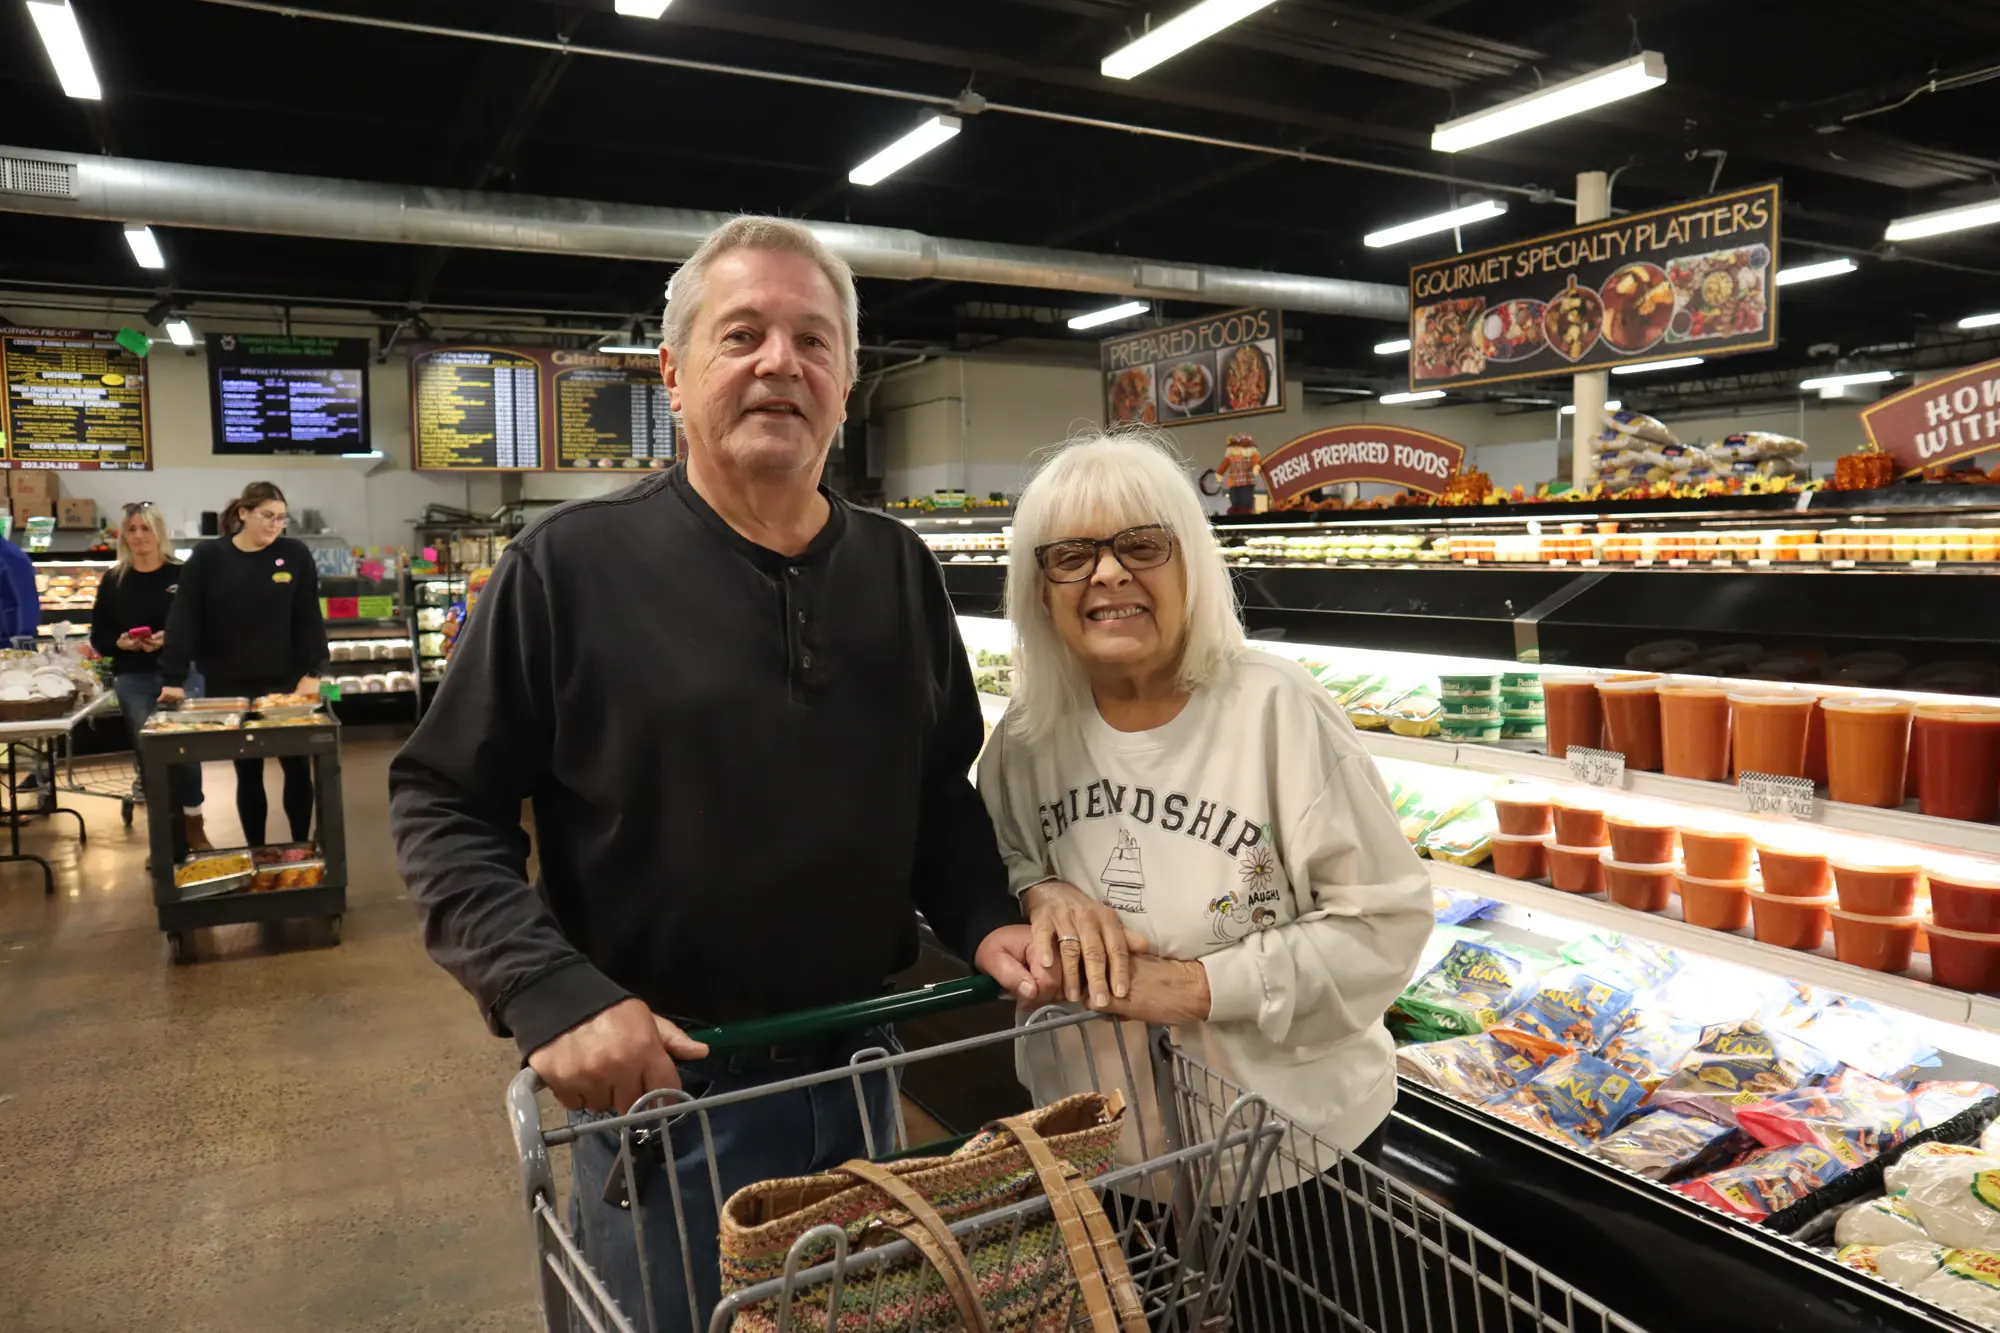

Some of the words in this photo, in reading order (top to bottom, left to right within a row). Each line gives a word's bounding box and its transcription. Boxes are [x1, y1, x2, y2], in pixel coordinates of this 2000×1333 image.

[1415, 255, 1513, 298] GOURMET
[1515, 228, 1632, 278] SPECIALTY
[1635, 198, 1769, 252] PLATTERS
[1110, 328, 1196, 369] PREPARED
[1199, 310, 1270, 349] FOODS
[551, 350, 621, 369] Catering
[624, 354, 661, 367] Men
[1915, 409, 2000, 458] WITH
[1269, 452, 1312, 489] FRESH
[1311, 442, 1390, 470] PREPARED
[1393, 444, 1450, 479] FOODS
[1462, 704, 1490, 714] Buitoni
[1740, 779, 1767, 795] FRESH
[1038, 778, 1263, 860] FRIENDSHIP
[1247, 888, 1281, 908] AAUGH!
[1540, 988, 1581, 1013] ANA
[1714, 1036, 1774, 1061] RANA
